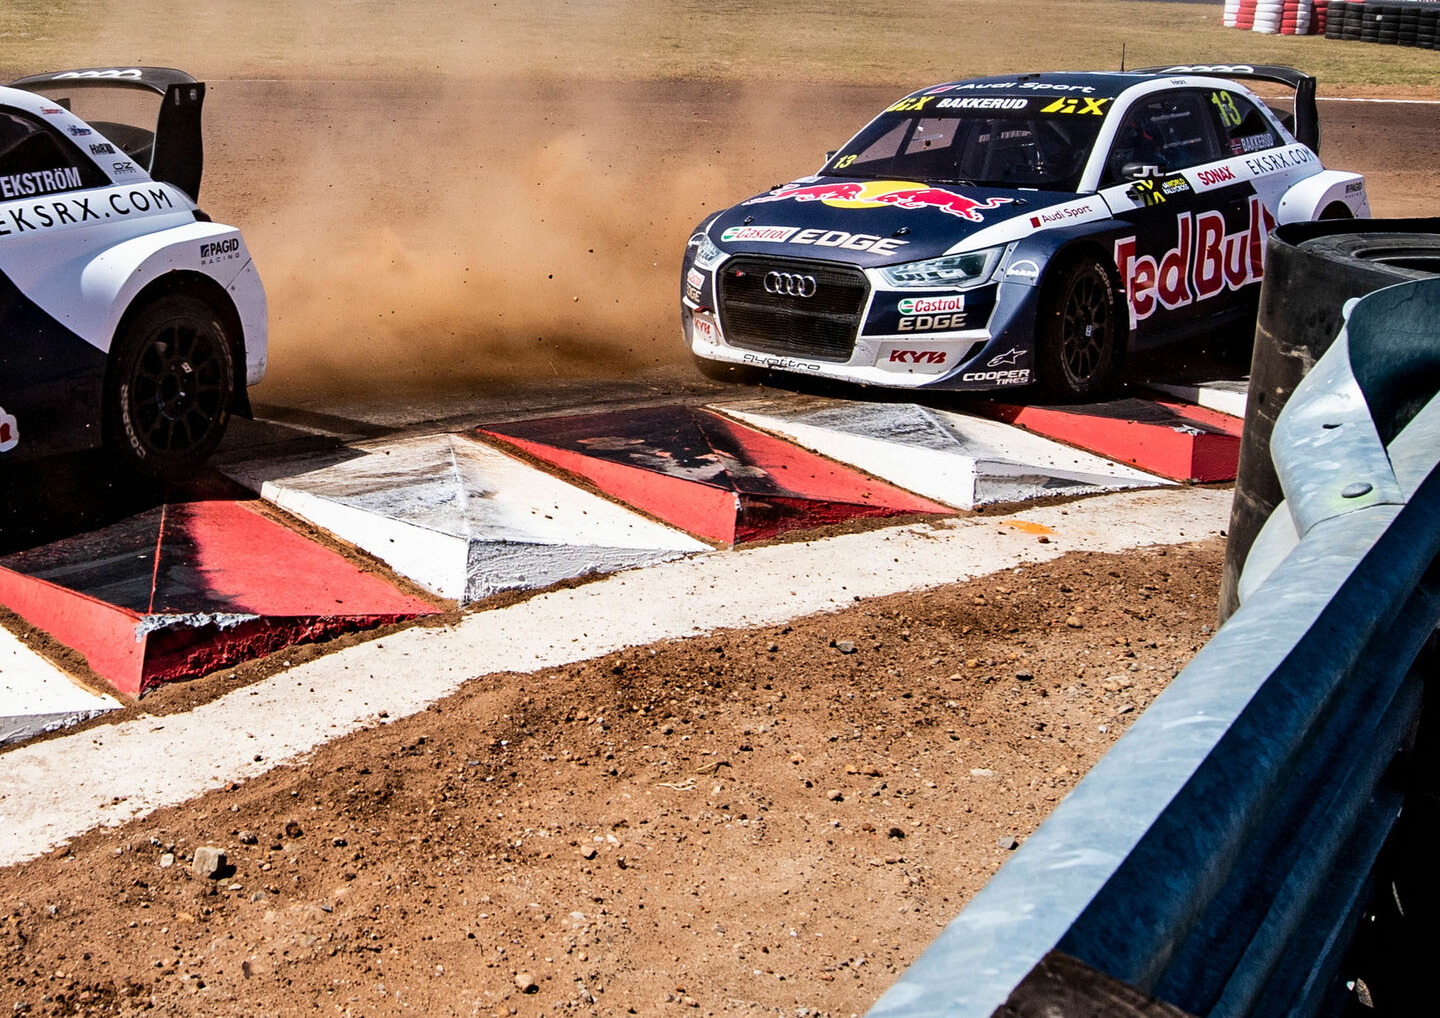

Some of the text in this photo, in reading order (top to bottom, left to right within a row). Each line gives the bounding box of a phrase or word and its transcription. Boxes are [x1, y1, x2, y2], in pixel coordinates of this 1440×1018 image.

[1018, 81, 1097, 94] Sport
[936, 98, 1028, 110] BAKKERUD
[1211, 90, 1242, 127] 13
[833, 154, 858, 169] 13
[1197, 147, 1316, 186] SONAX EKSRX.COM
[1041, 205, 1092, 223] Audi Sport
[210, 238, 239, 256] PAGID
[736, 228, 910, 257] Castrol EDGE
[201, 252, 240, 266] RACING
[914, 297, 961, 313] Castrol
[897, 313, 968, 331] EDGE
[888, 349, 947, 363] KYB
[962, 369, 1030, 382] COOPER
[995, 376, 1029, 386] TIRES
